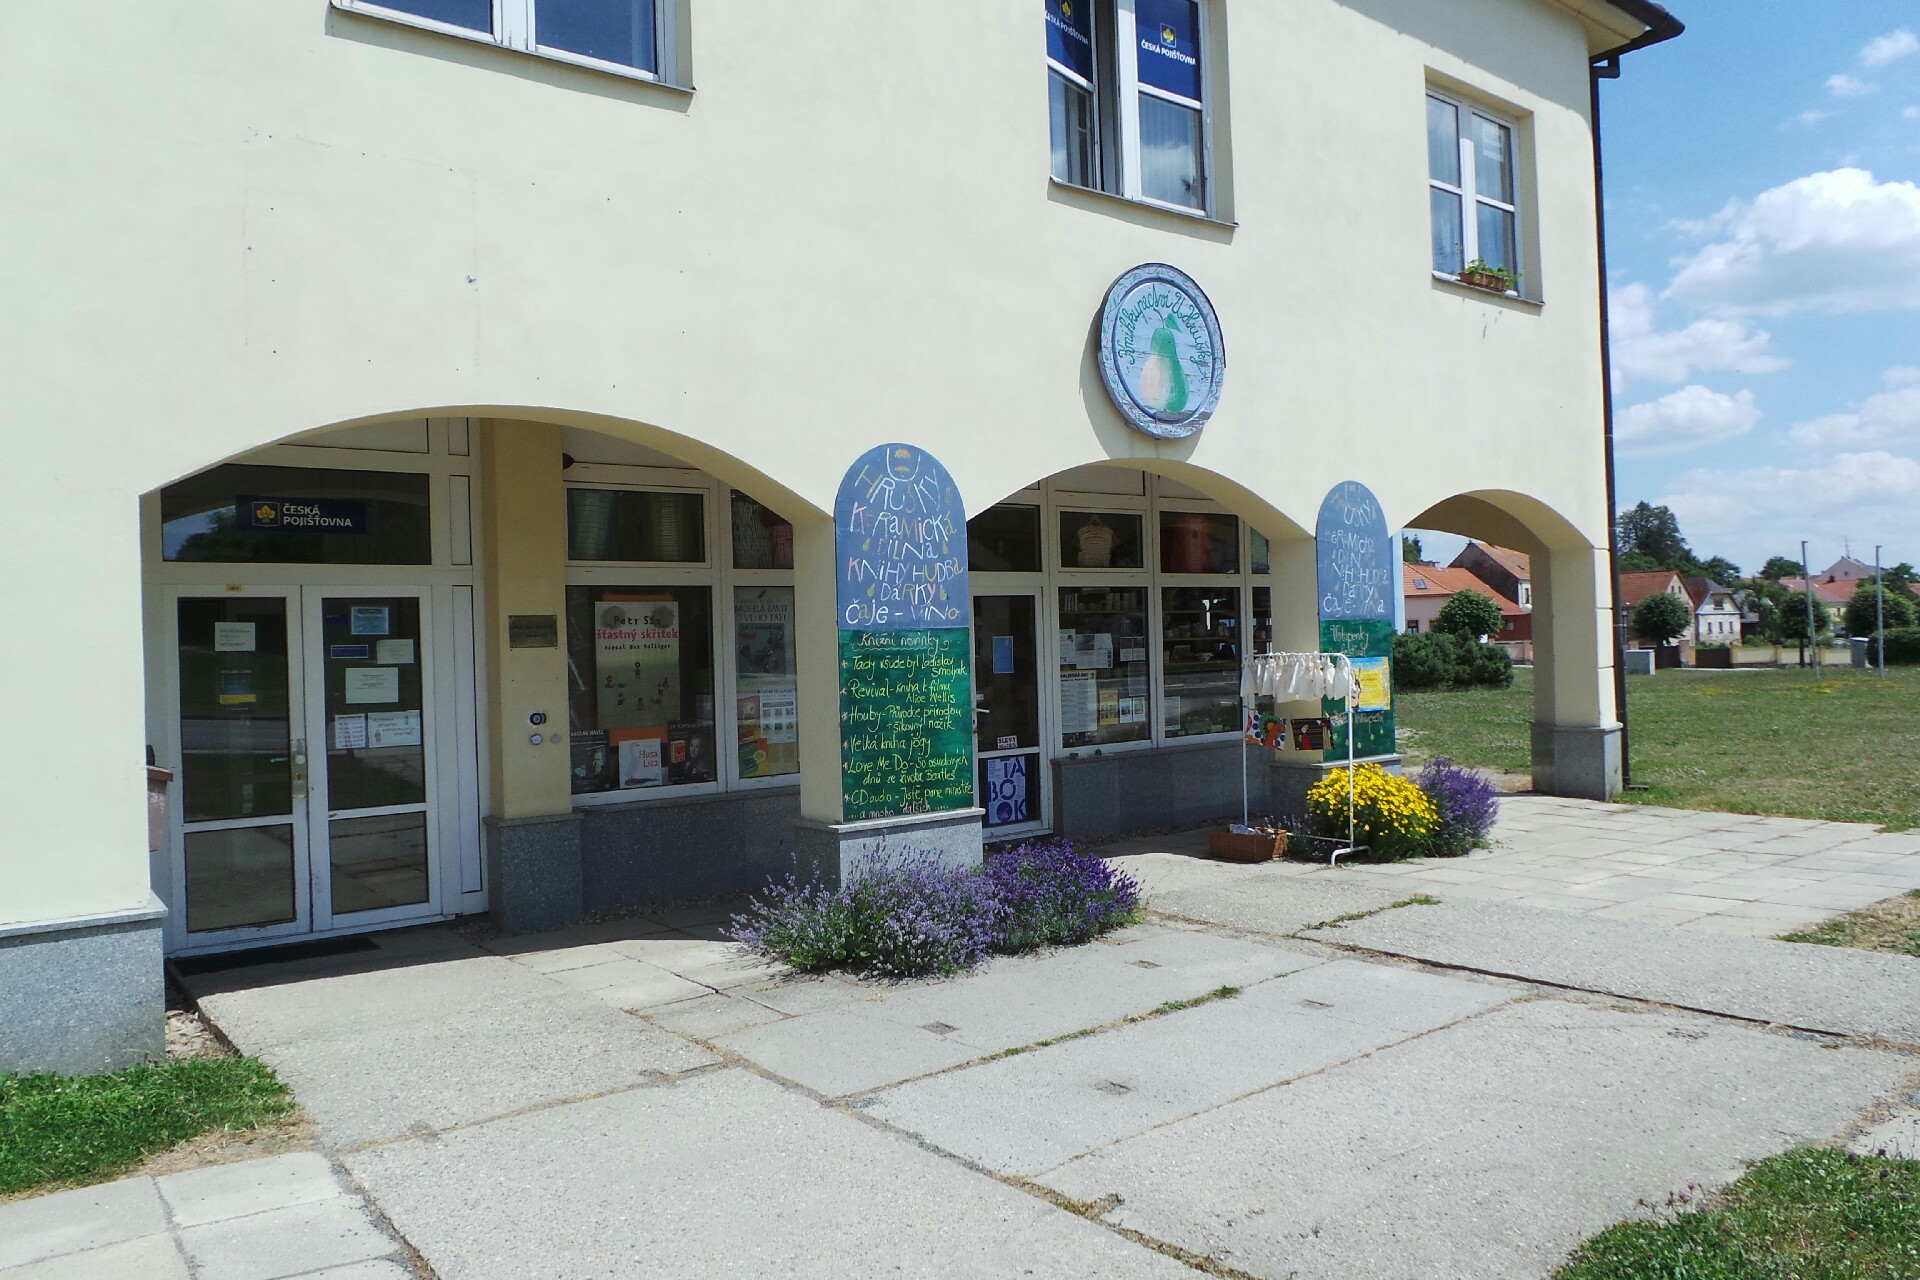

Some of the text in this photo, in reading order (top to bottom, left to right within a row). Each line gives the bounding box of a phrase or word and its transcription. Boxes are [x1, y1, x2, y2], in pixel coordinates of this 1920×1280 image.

[1045, 10, 1089, 45] ČESKÁ POJIŠŤOVNA
[1141, 39, 1197, 66] ČESKÁ POJIŠŤOVNA
[1117, 283, 1174, 365] Knihkupectví
[1171, 291, 1186, 319] U
[283, 502, 320, 515] ČESKÁ
[283, 514, 352, 527] POJIŠŤOVNA
[613, 615, 639, 625] Petr
[845, 599, 889, 626] Čaje
[597, 628, 678, 641] šťastný skřítek
[858, 631, 939, 657] Knižní novinky
[852, 653, 955, 680] Tady všude byl Ladislav
[922, 678, 928, 692] k
[928, 678, 951, 696] filmu
[905, 691, 956, 704] Alice Nellis
[923, 704, 962, 725] přírodou
[928, 716, 956, 730] nožík
[639, 750, 658, 758] Husa
[850, 732, 931, 760] Velká kniha jógy
[847, 757, 874, 774] Love
[876, 756, 890, 770] Me
[928, 748, 968, 772] osudových
[863, 767, 956, 785] dnů ze života Beatles
[924, 787, 944, 804] pane
[944, 779, 974, 796] ministře
[868, 806, 895, 819] mnoho
